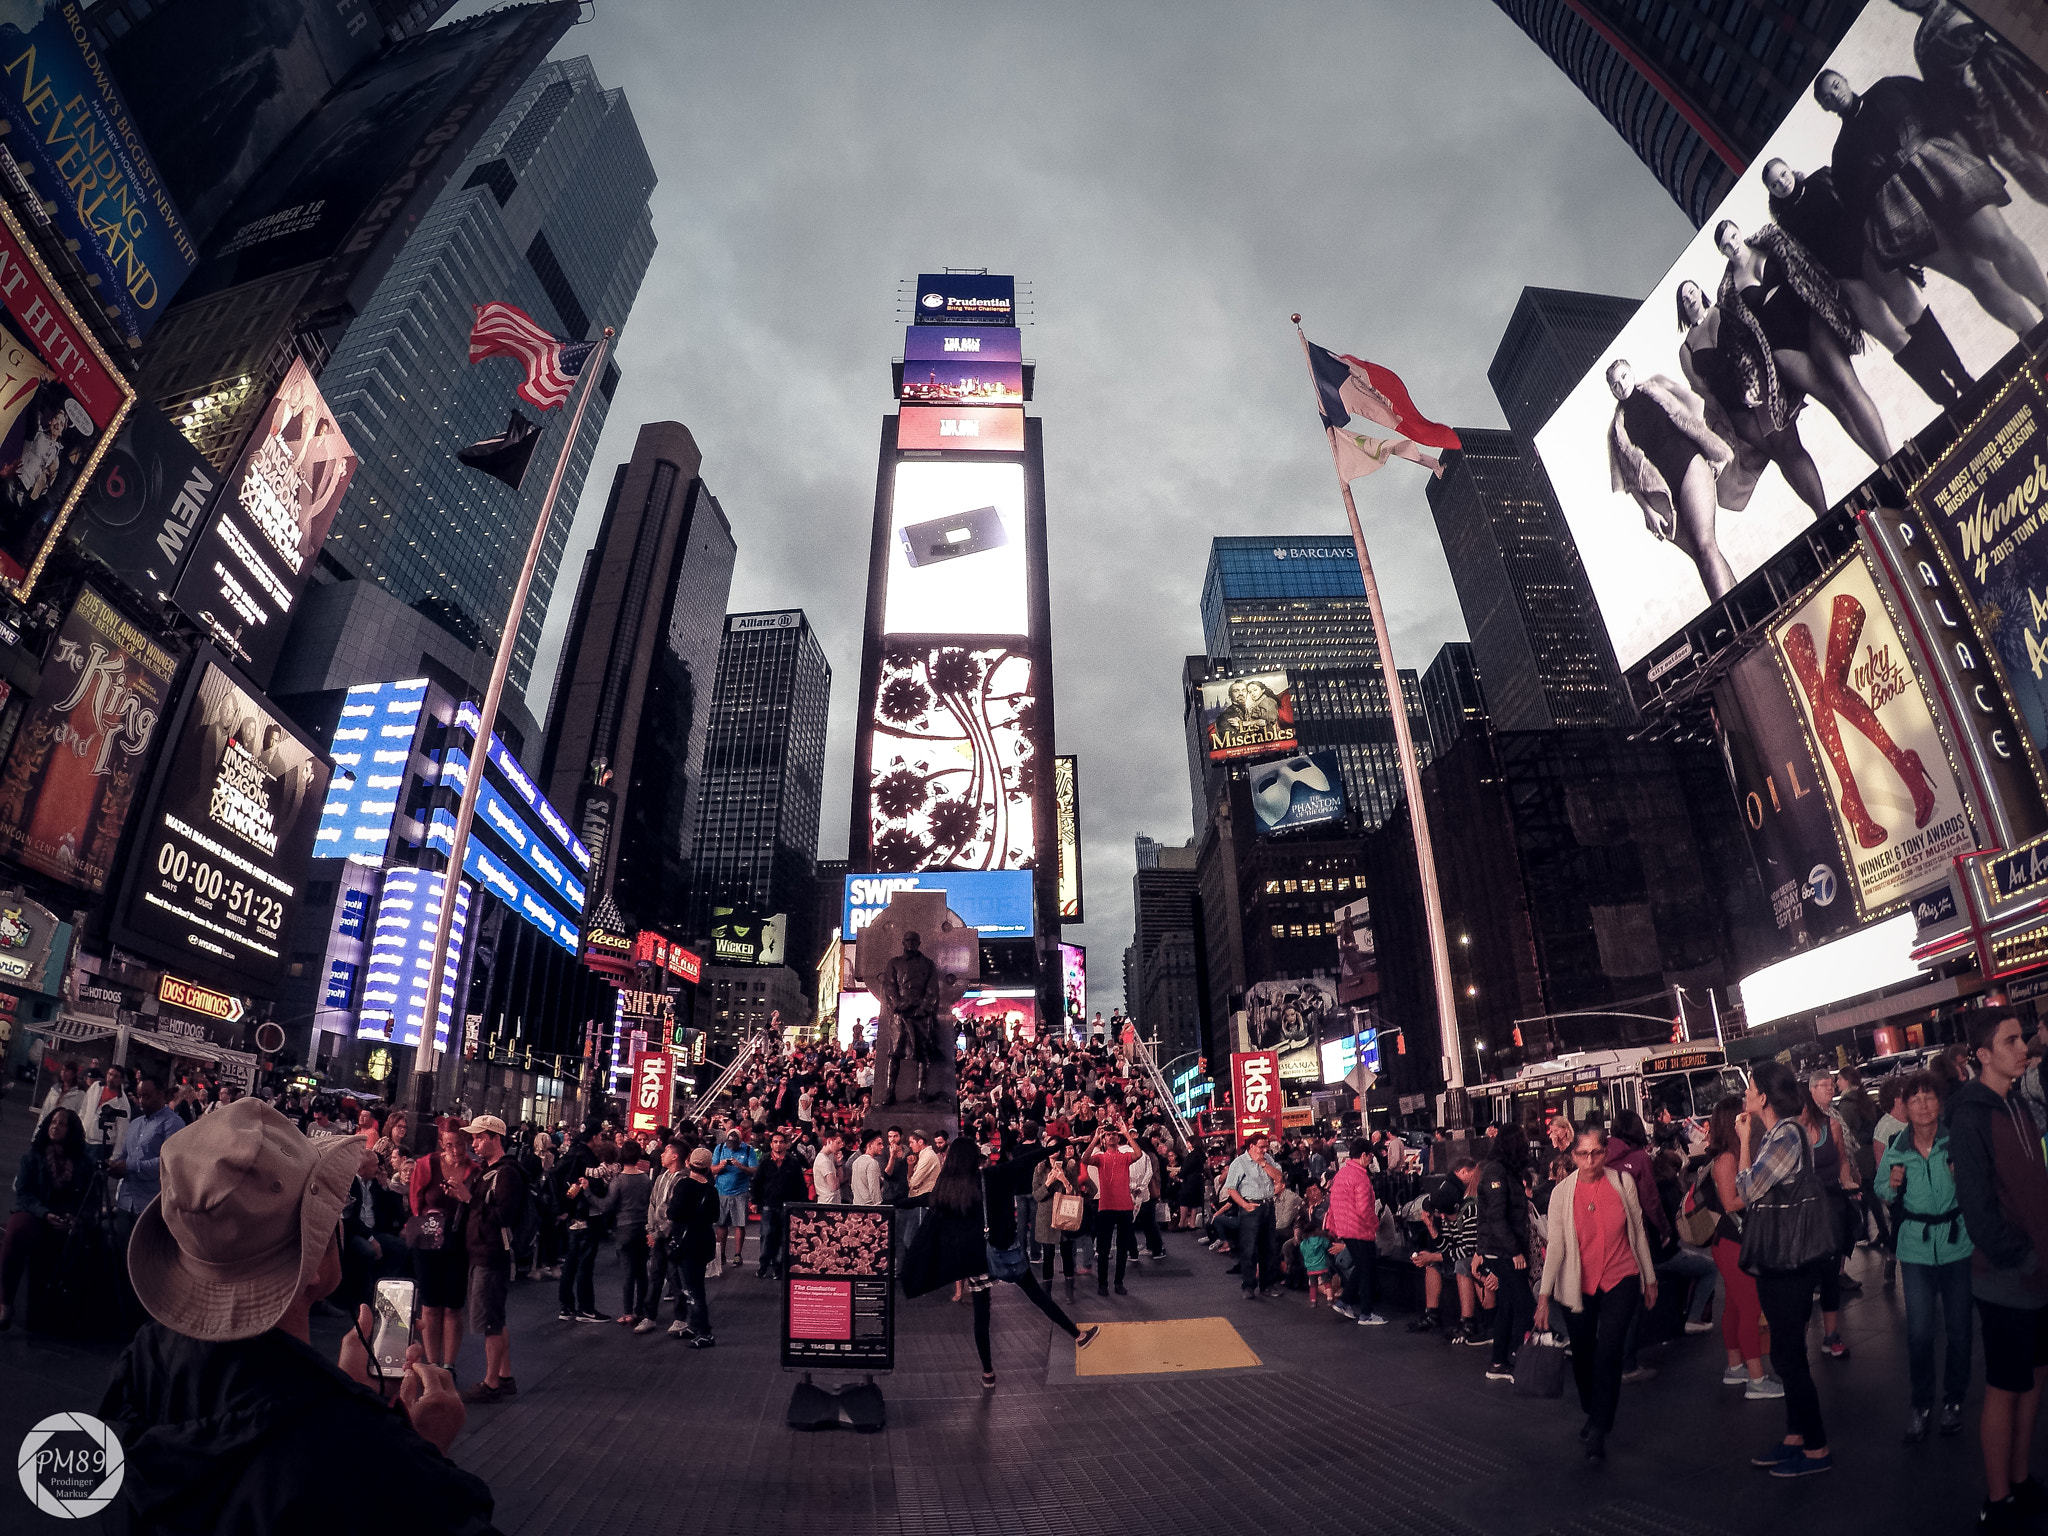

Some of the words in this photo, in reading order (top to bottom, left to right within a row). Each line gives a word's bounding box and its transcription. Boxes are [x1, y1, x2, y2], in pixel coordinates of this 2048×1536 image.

[62, 3, 123, 116] BROADWAY'S
[115, 115, 158, 188] BIGGEST
[152, 188, 180, 231] NEW
[173, 230, 197, 268] HIT!
[91, 100, 122, 152] MATTHEW
[118, 151, 148, 204] MORRISON
[3, 44, 158, 311] NEVERLAND
[65, 91, 148, 239] FINDING
[947, 297, 1010, 307] Prudential
[261, 433, 302, 497] IMAGINE
[1933, 487, 1951, 508] THE
[1948, 466, 1971, 495] MOST
[1968, 404, 2033, 475] AWARD-WINNING
[1943, 480, 1979, 517] MUSICAL
[1976, 467, 1988, 485] OF
[1986, 451, 2006, 474] THE
[2002, 418, 2038, 459] SEASON!
[156, 465, 216, 566] NEW
[1957, 453, 2048, 562] Winner
[1290, 548, 1354, 558] BARCLAYS
[1989, 535, 2015, 567] 2015
[2011, 513, 2040, 546] TONY
[76, 603, 97, 621] BEST
[95, 619, 126, 647] REVIVAL
[126, 643, 137, 655] OF
[135, 651, 142, 660] A
[140, 656, 172, 683] MUSICAL
[80, 588, 102, 612] 2015
[98, 603, 122, 629] TONY
[118, 621, 147, 651] AWARD
[146, 641, 178, 675] WINNER!
[738, 618, 776, 629] Allianz
[53, 635, 86, 674] The
[53, 641, 159, 757] King
[1871, 666, 1914, 711] Boots
[89, 719, 125, 777] I
[1211, 723, 1294, 751] Misérables
[1238, 720, 1260, 733] Les
[219, 761, 270, 810] DRAGONS
[223, 745, 266, 789] IMAGINE
[1291, 796, 1341, 813] PHANTOM
[1318, 806, 1339, 814] OPERA
[1746, 761, 1811, 831] OIL
[0, 822, 33, 847] INCOLN
[74, 858, 104, 878] HEATER
[165, 813, 194, 839] WATCH
[191, 830, 223, 857] IMAGINE
[221, 847, 254, 874] DRAGONS
[1858, 847, 1895, 878] WINNER!
[1894, 845, 1901, 860] 6
[1901, 833, 1927, 858] TONY
[1926, 814, 1965, 846] AWARDS
[1862, 864, 1900, 888] INCLUDING
[1900, 852, 1923, 870] BEST
[1925, 832, 1969, 858] MUSICAL
[158, 842, 284, 930] 00:00:51:23
[1773, 888, 1799, 916] SUNDAY
[1801, 886, 1815, 900] abc
[2008, 860, 2028, 891] An
[162, 879, 178, 893] DAYS
[195, 896, 214, 910] HOURS
[226, 911, 247, 926] MINUTES
[256, 925, 278, 940] SECONDS
[1776, 908, 1792, 930] SEPT
[1792, 902, 1803, 921] 27
[587, 928, 632, 949] Reese's
[89, 987, 104, 1000] HOT
[103, 990, 122, 1003] DOGS
[163, 980, 186, 1003] DOS
[185, 987, 230, 1018] CAMINOS
[168, 1018, 184, 1035] HOT
[183, 1022, 205, 1039] DOGS
[640, 1057, 666, 1108] tkts
[1244, 1056, 1272, 1113] tkts
[1655, 1059, 1668, 1071] NOT
[1671, 1057, 1679, 1069] IN
[1681, 1054, 1707, 1067] SERVICE
